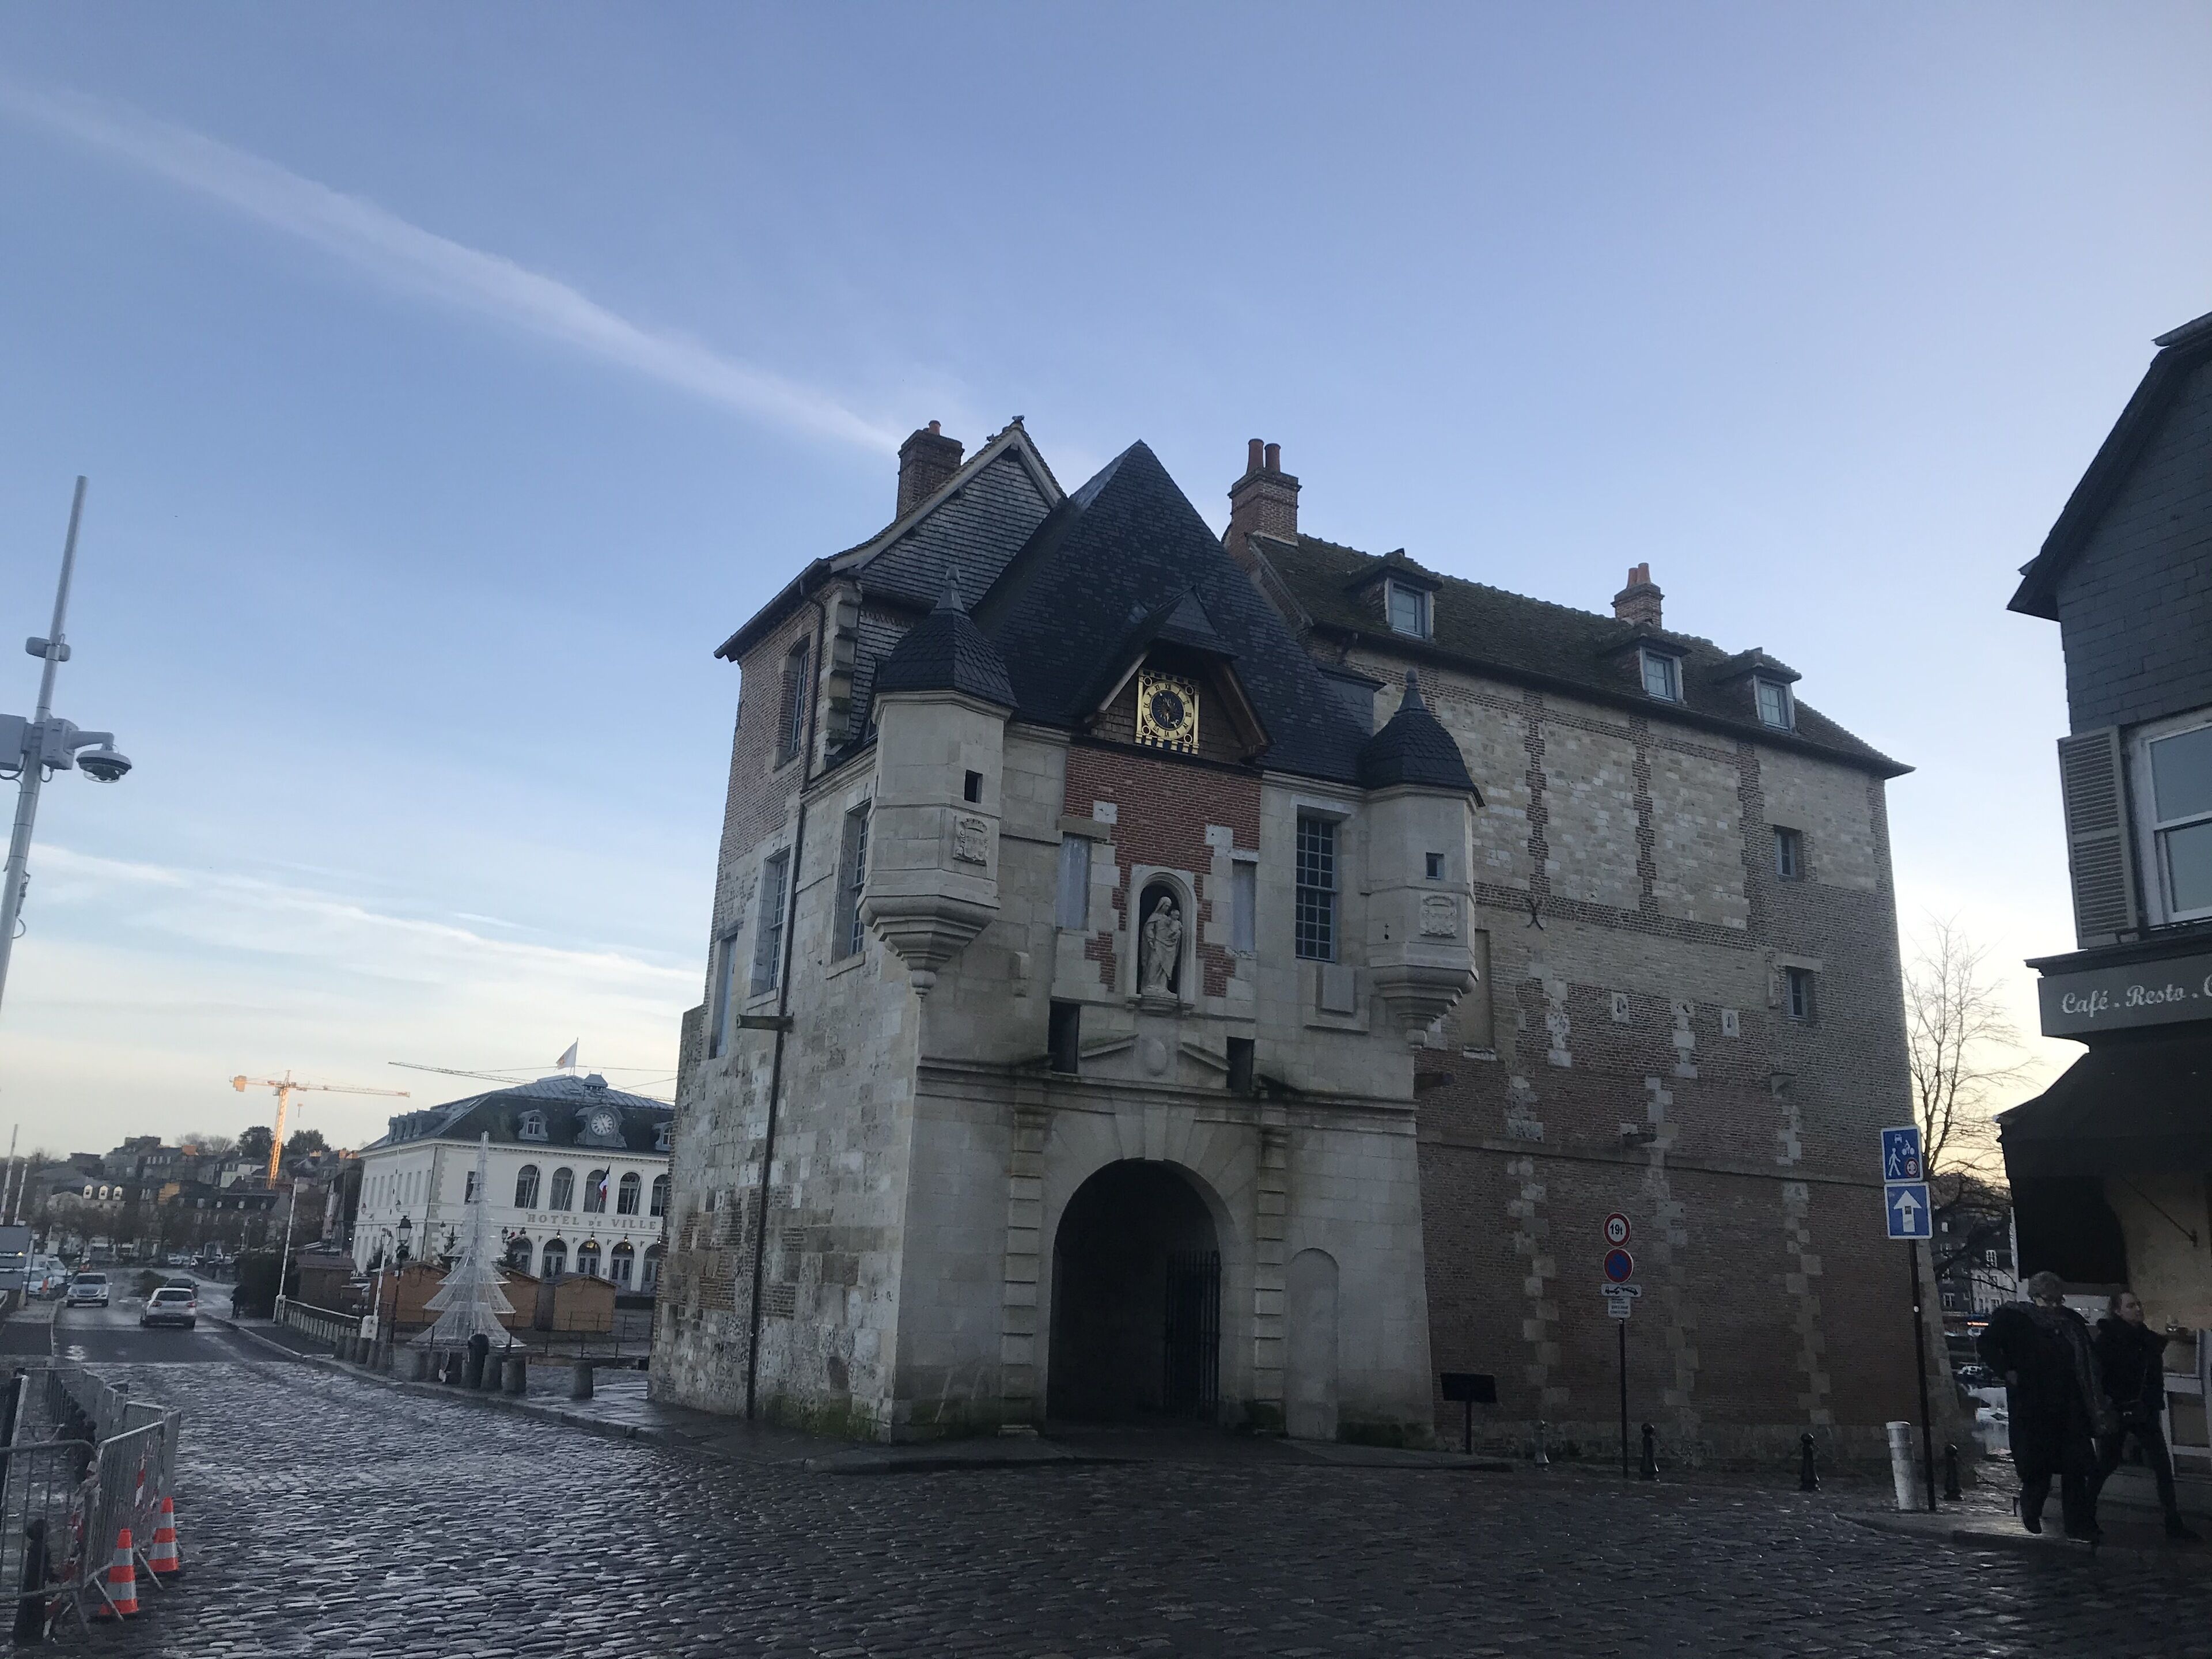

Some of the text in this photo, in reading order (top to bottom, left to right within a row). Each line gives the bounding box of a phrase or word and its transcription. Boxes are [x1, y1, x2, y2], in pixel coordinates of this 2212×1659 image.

[2062, 990, 2109, 1017] Café
[2126, 984, 2186, 1007] Resto
[527, 1214, 579, 1225] HOTEL
[611, 1218, 656, 1229] VILLE
[1610, 1224, 1623, 1235] 19t
